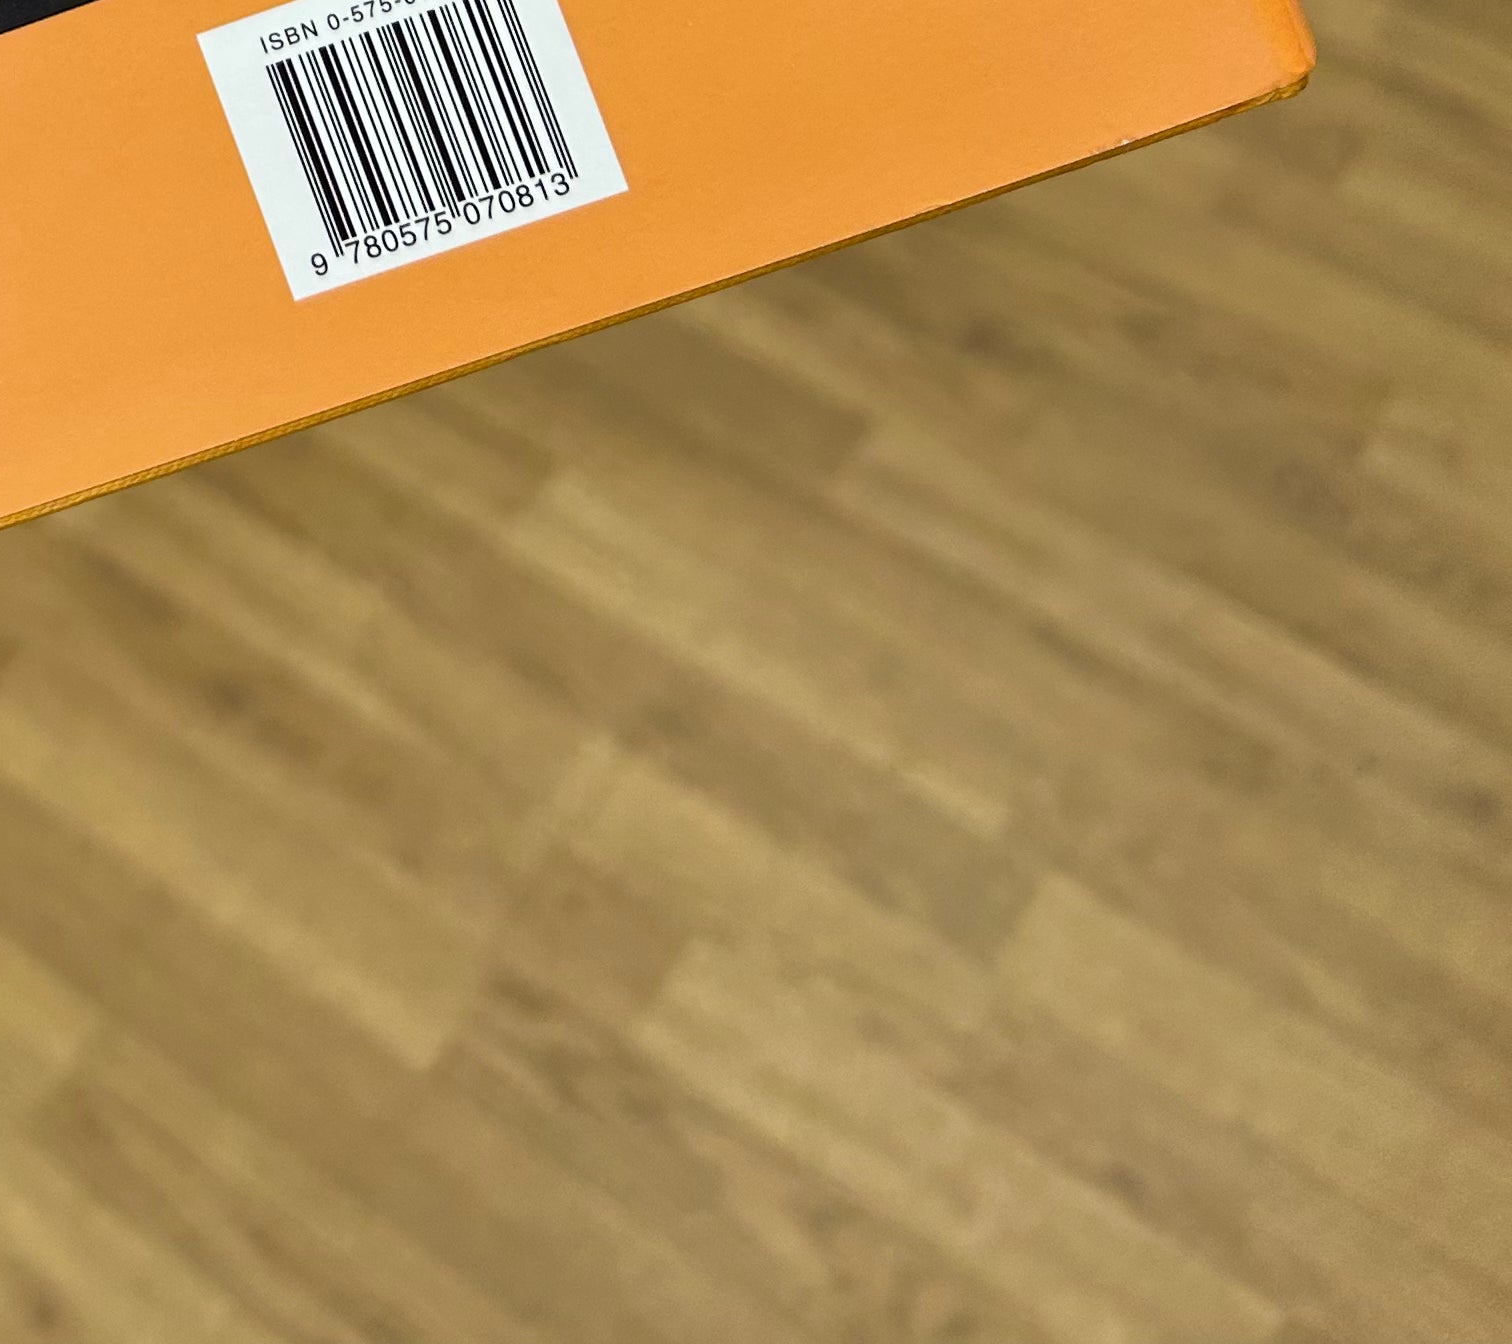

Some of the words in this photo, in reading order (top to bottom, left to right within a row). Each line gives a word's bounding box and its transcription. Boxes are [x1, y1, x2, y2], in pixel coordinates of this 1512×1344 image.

[259, 18, 320, 55] ISBN
[310, 253, 329, 276] 9
[345, 211, 453, 265] 780575
[462, 172, 570, 226] 070813
